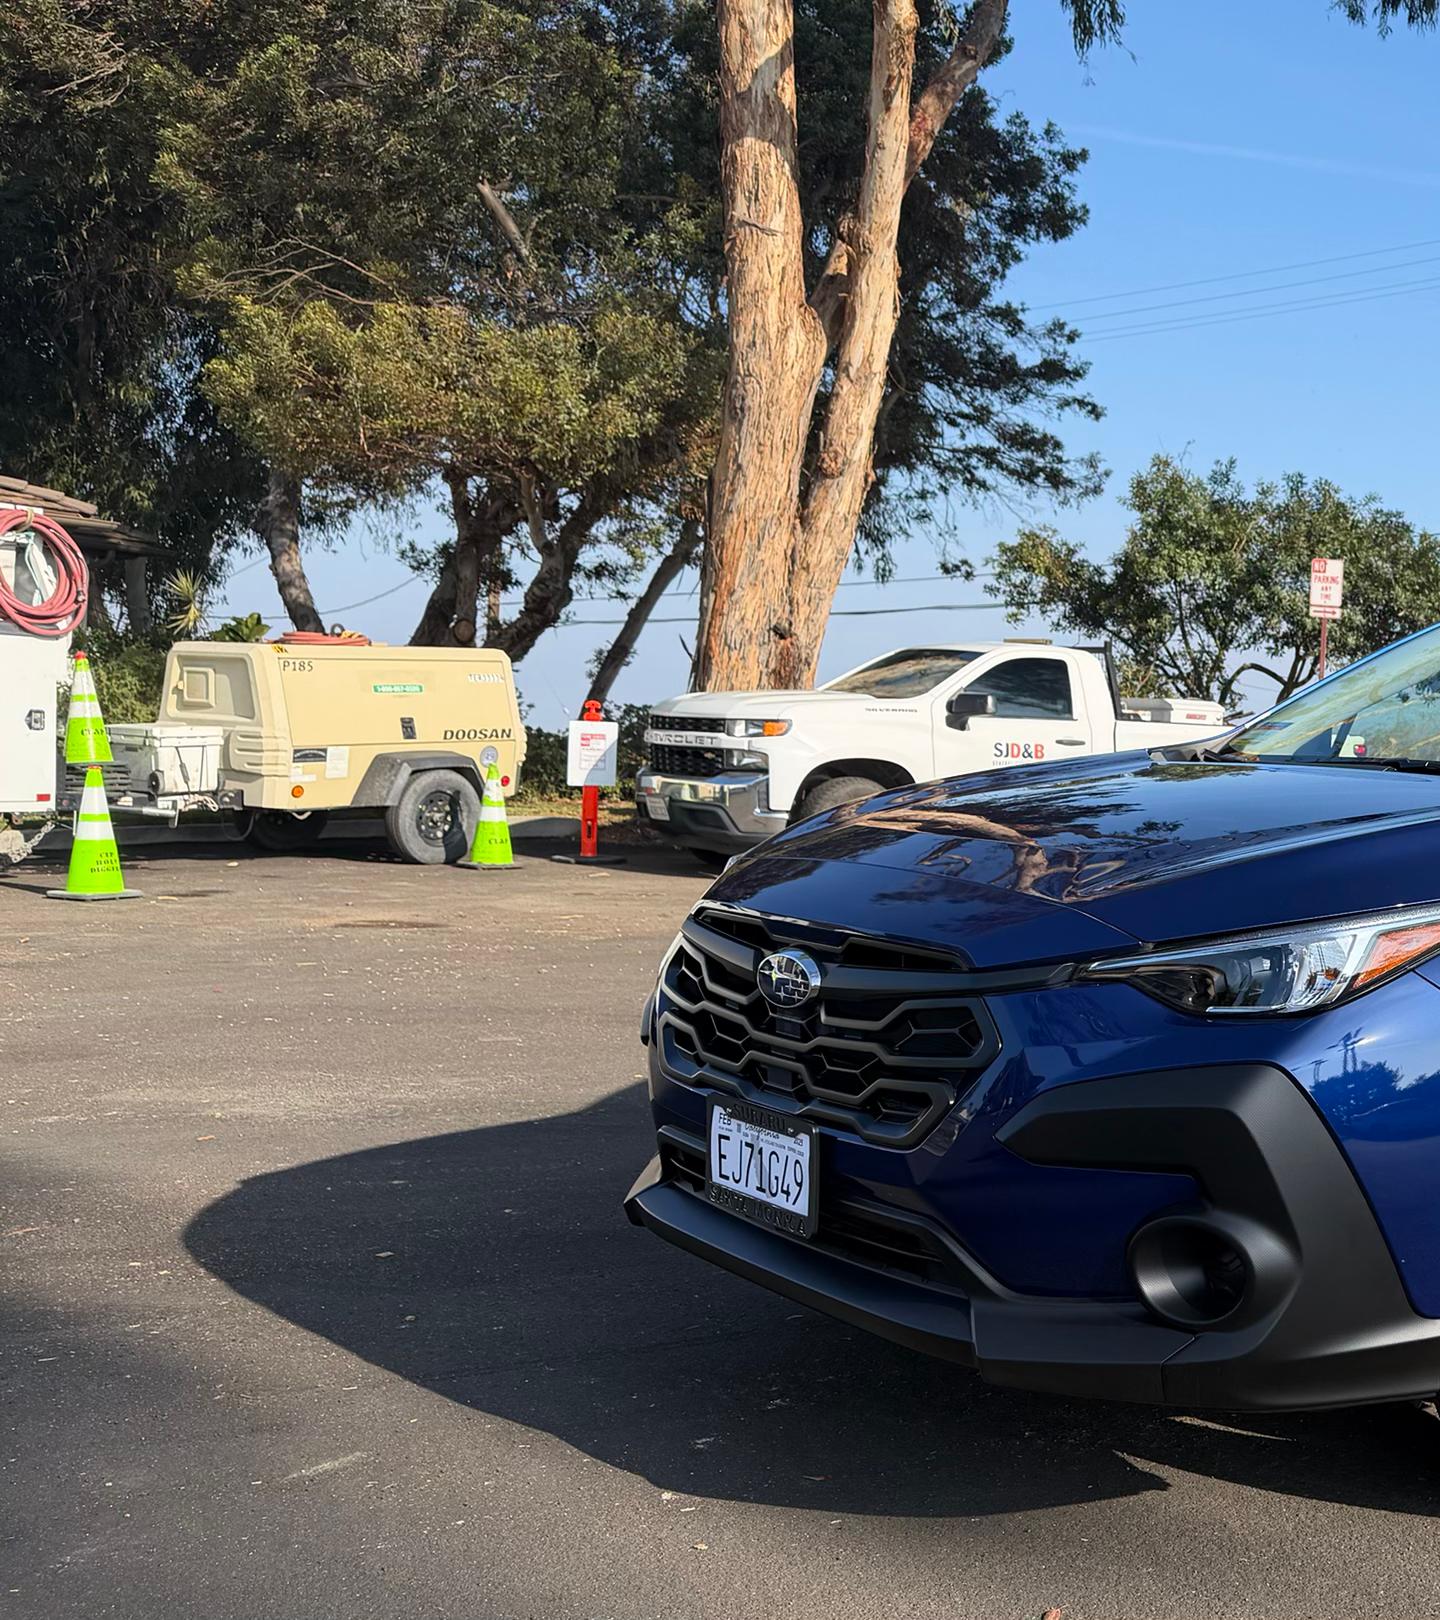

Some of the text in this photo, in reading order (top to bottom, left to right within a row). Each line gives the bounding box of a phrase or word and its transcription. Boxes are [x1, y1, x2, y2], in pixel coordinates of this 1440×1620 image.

[282, 660, 314, 672] P185
[443, 728, 512, 740] DOOSAN
[993, 742, 1044, 759] SJD&B
[733, 1103, 786, 1129] SUBARU
[718, 1133, 804, 1206] EJ71G49
[709, 1186, 807, 1237] SANTA MONICA
